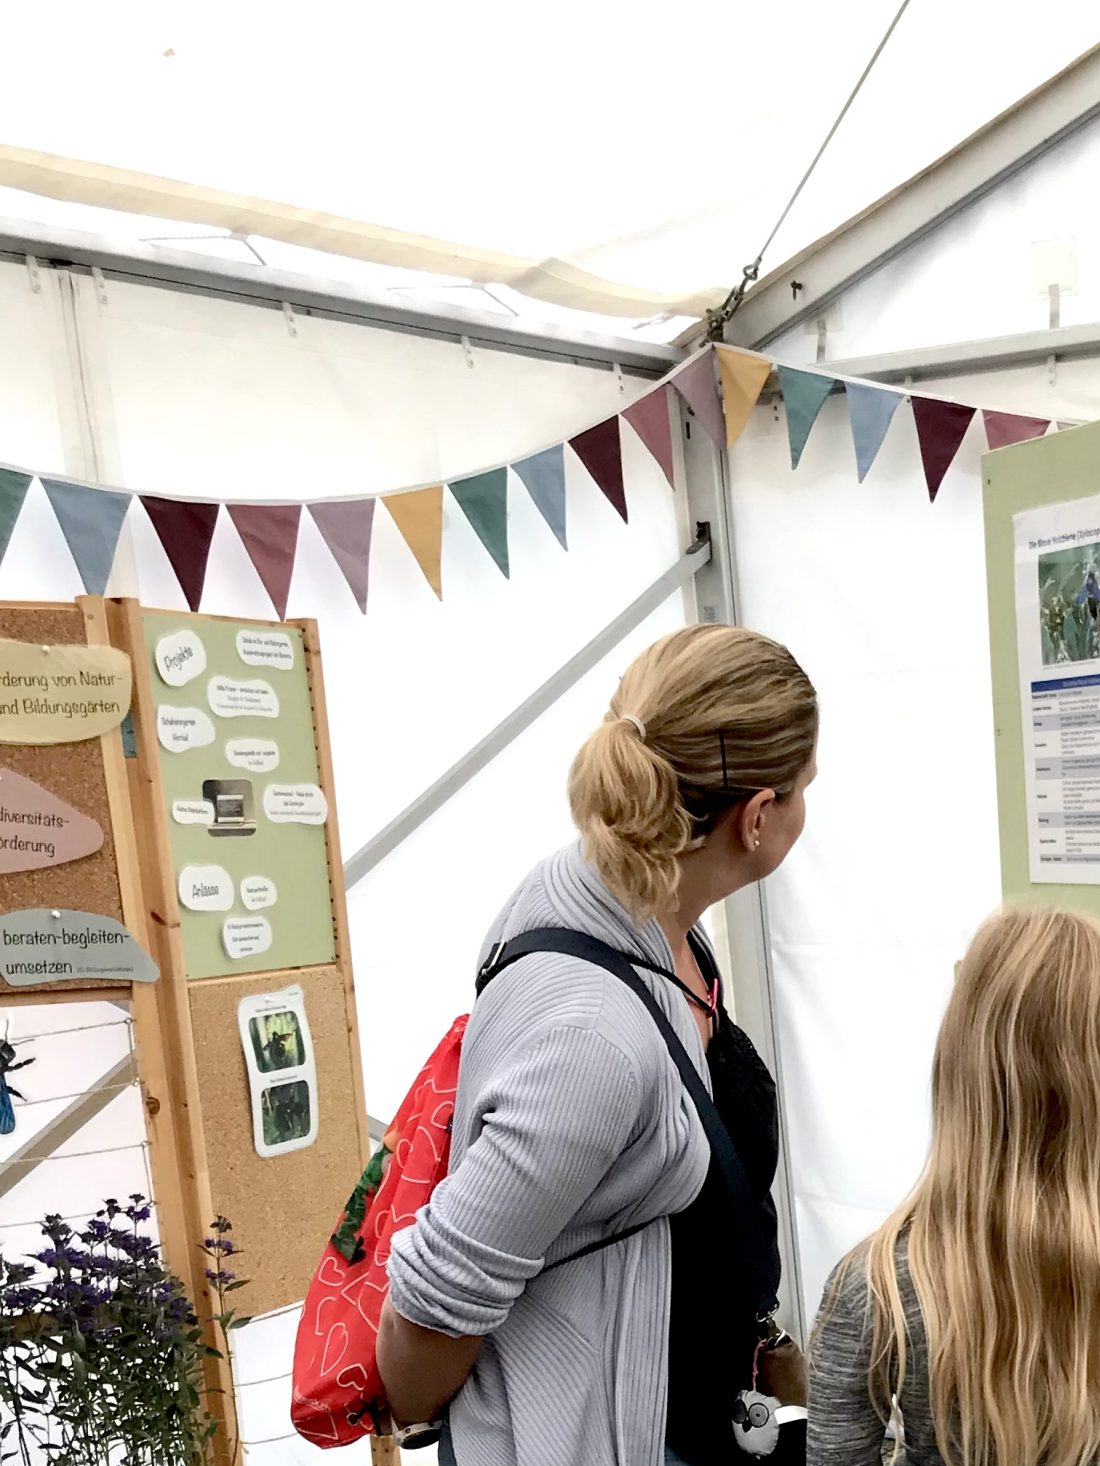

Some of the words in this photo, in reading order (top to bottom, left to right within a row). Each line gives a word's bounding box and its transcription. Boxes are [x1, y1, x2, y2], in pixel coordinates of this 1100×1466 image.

[163, 646, 194, 672] Projekte
[0, 670, 49, 692] derung
[52, 675, 77, 687] von
[79, 670, 123, 687] Natur-
[22, 698, 120, 719] Bildungsgärten
[2, 927, 131, 949] beraten-begleiten-
[5, 960, 73, 975] umsetzen
